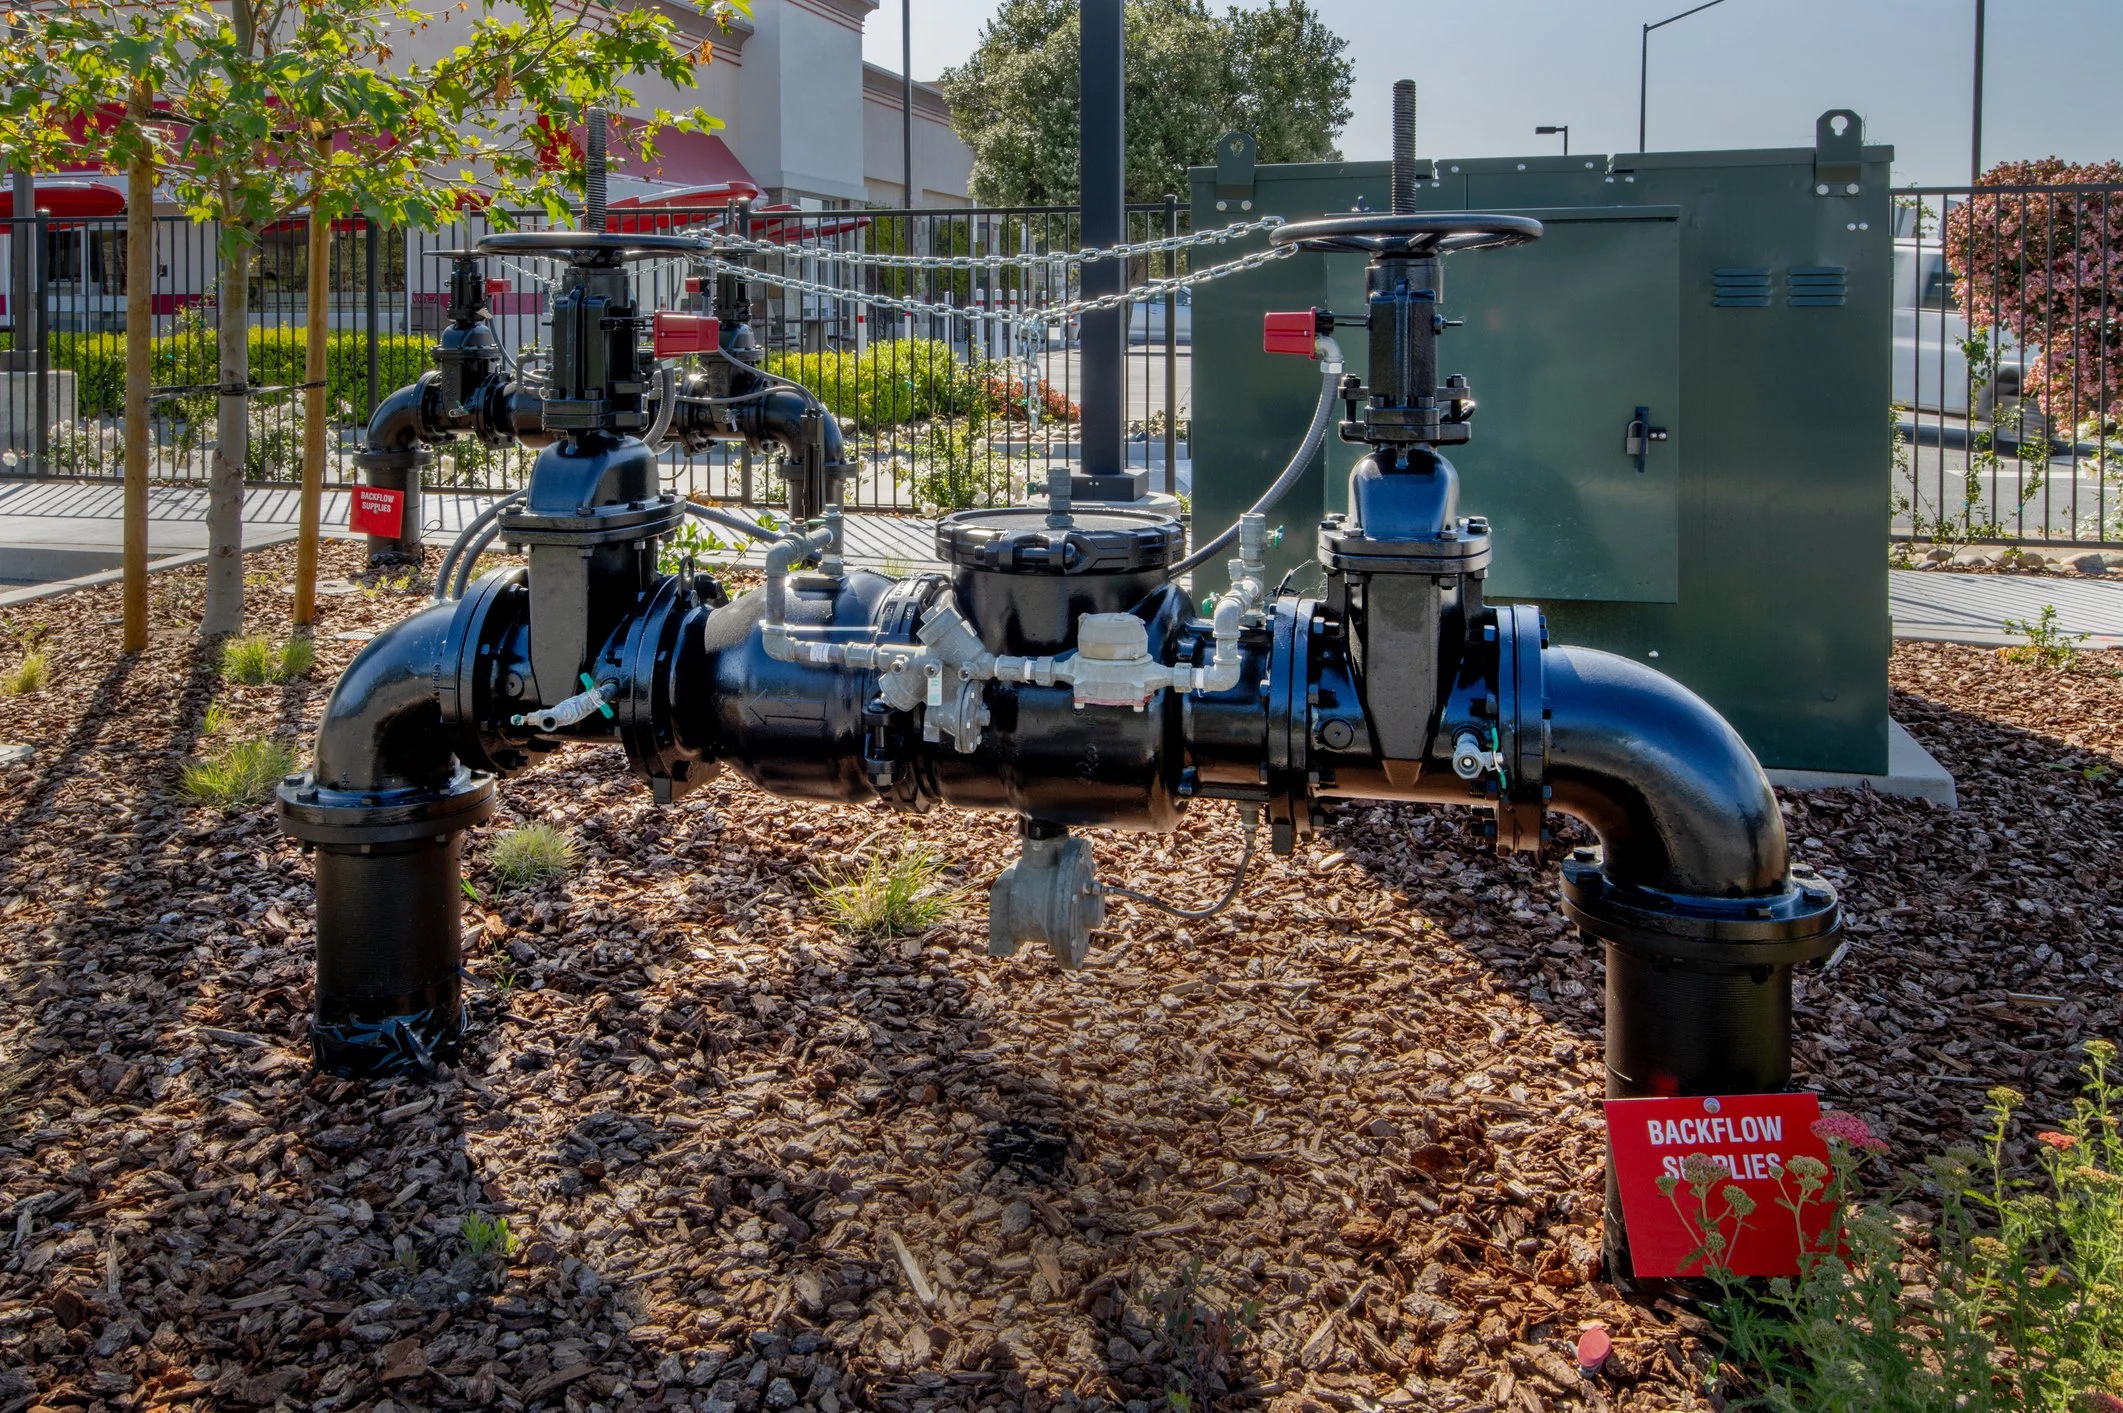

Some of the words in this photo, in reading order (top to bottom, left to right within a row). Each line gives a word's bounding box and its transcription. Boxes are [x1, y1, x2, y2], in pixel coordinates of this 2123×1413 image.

[360, 491, 394, 503] BACKFLOW
[362, 501, 392, 512] SUPPLIES
[1647, 1115, 1782, 1145] BACKFLOW
[1662, 1153, 1782, 1181] SLIES
